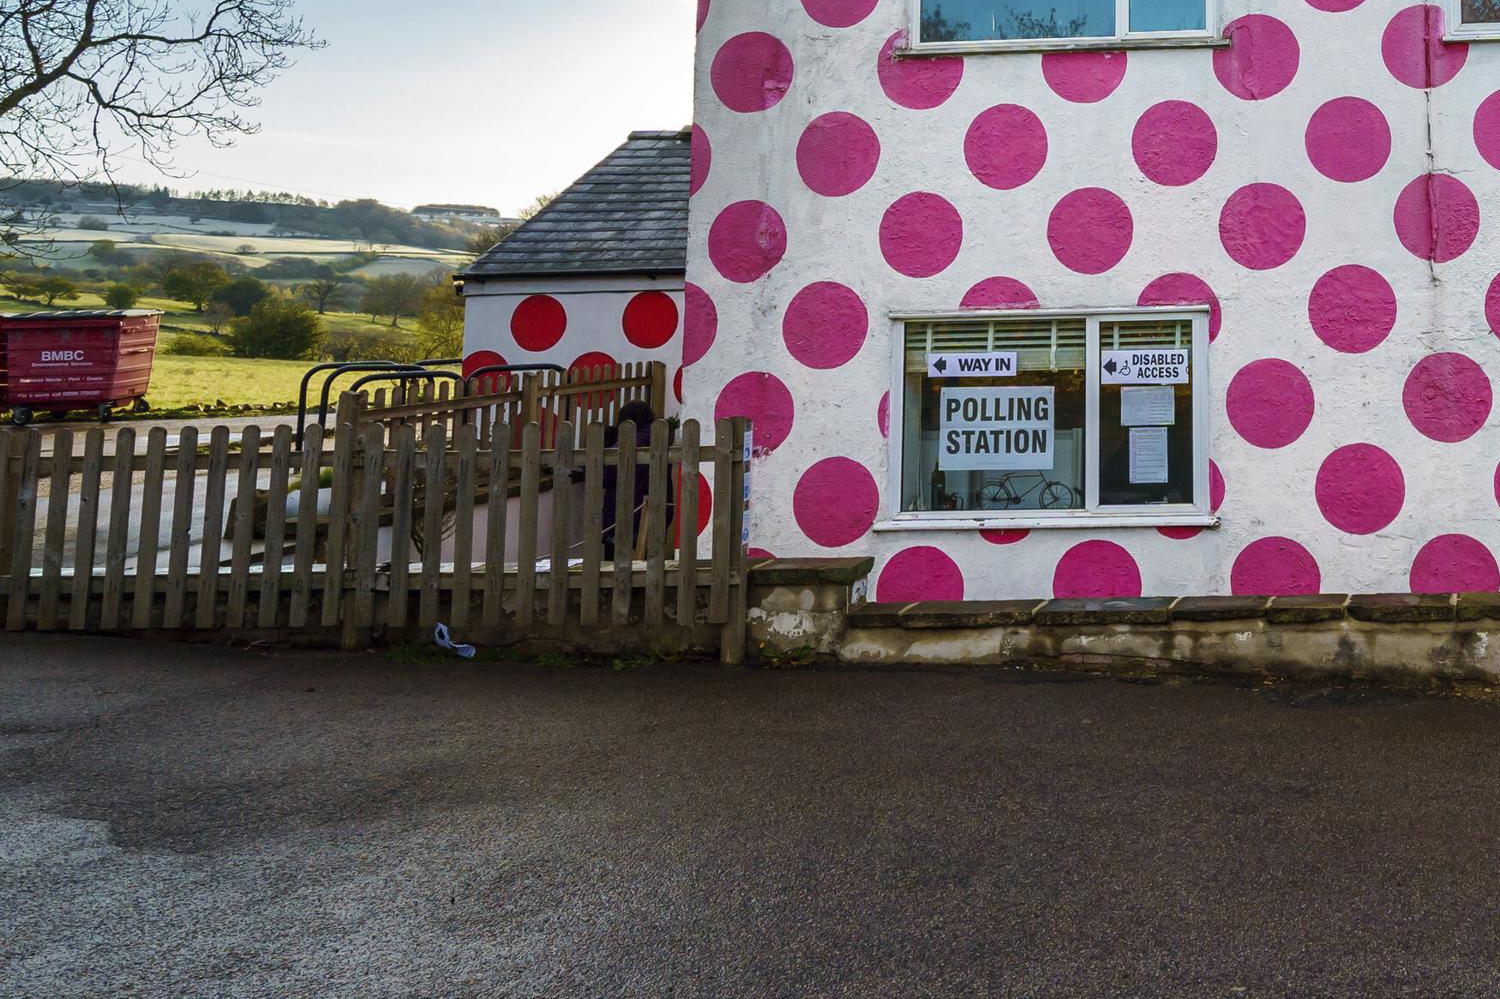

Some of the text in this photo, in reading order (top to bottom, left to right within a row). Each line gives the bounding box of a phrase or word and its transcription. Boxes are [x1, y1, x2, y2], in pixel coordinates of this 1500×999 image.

[41, 350, 84, 361] BMBC
[1132, 353, 1185, 366] DISABLED
[958, 357, 1011, 372] WAY IN
[1137, 366, 1180, 379] ACCESS
[946, 396, 1049, 422] POLLING
[946, 429, 1047, 455] STATION
